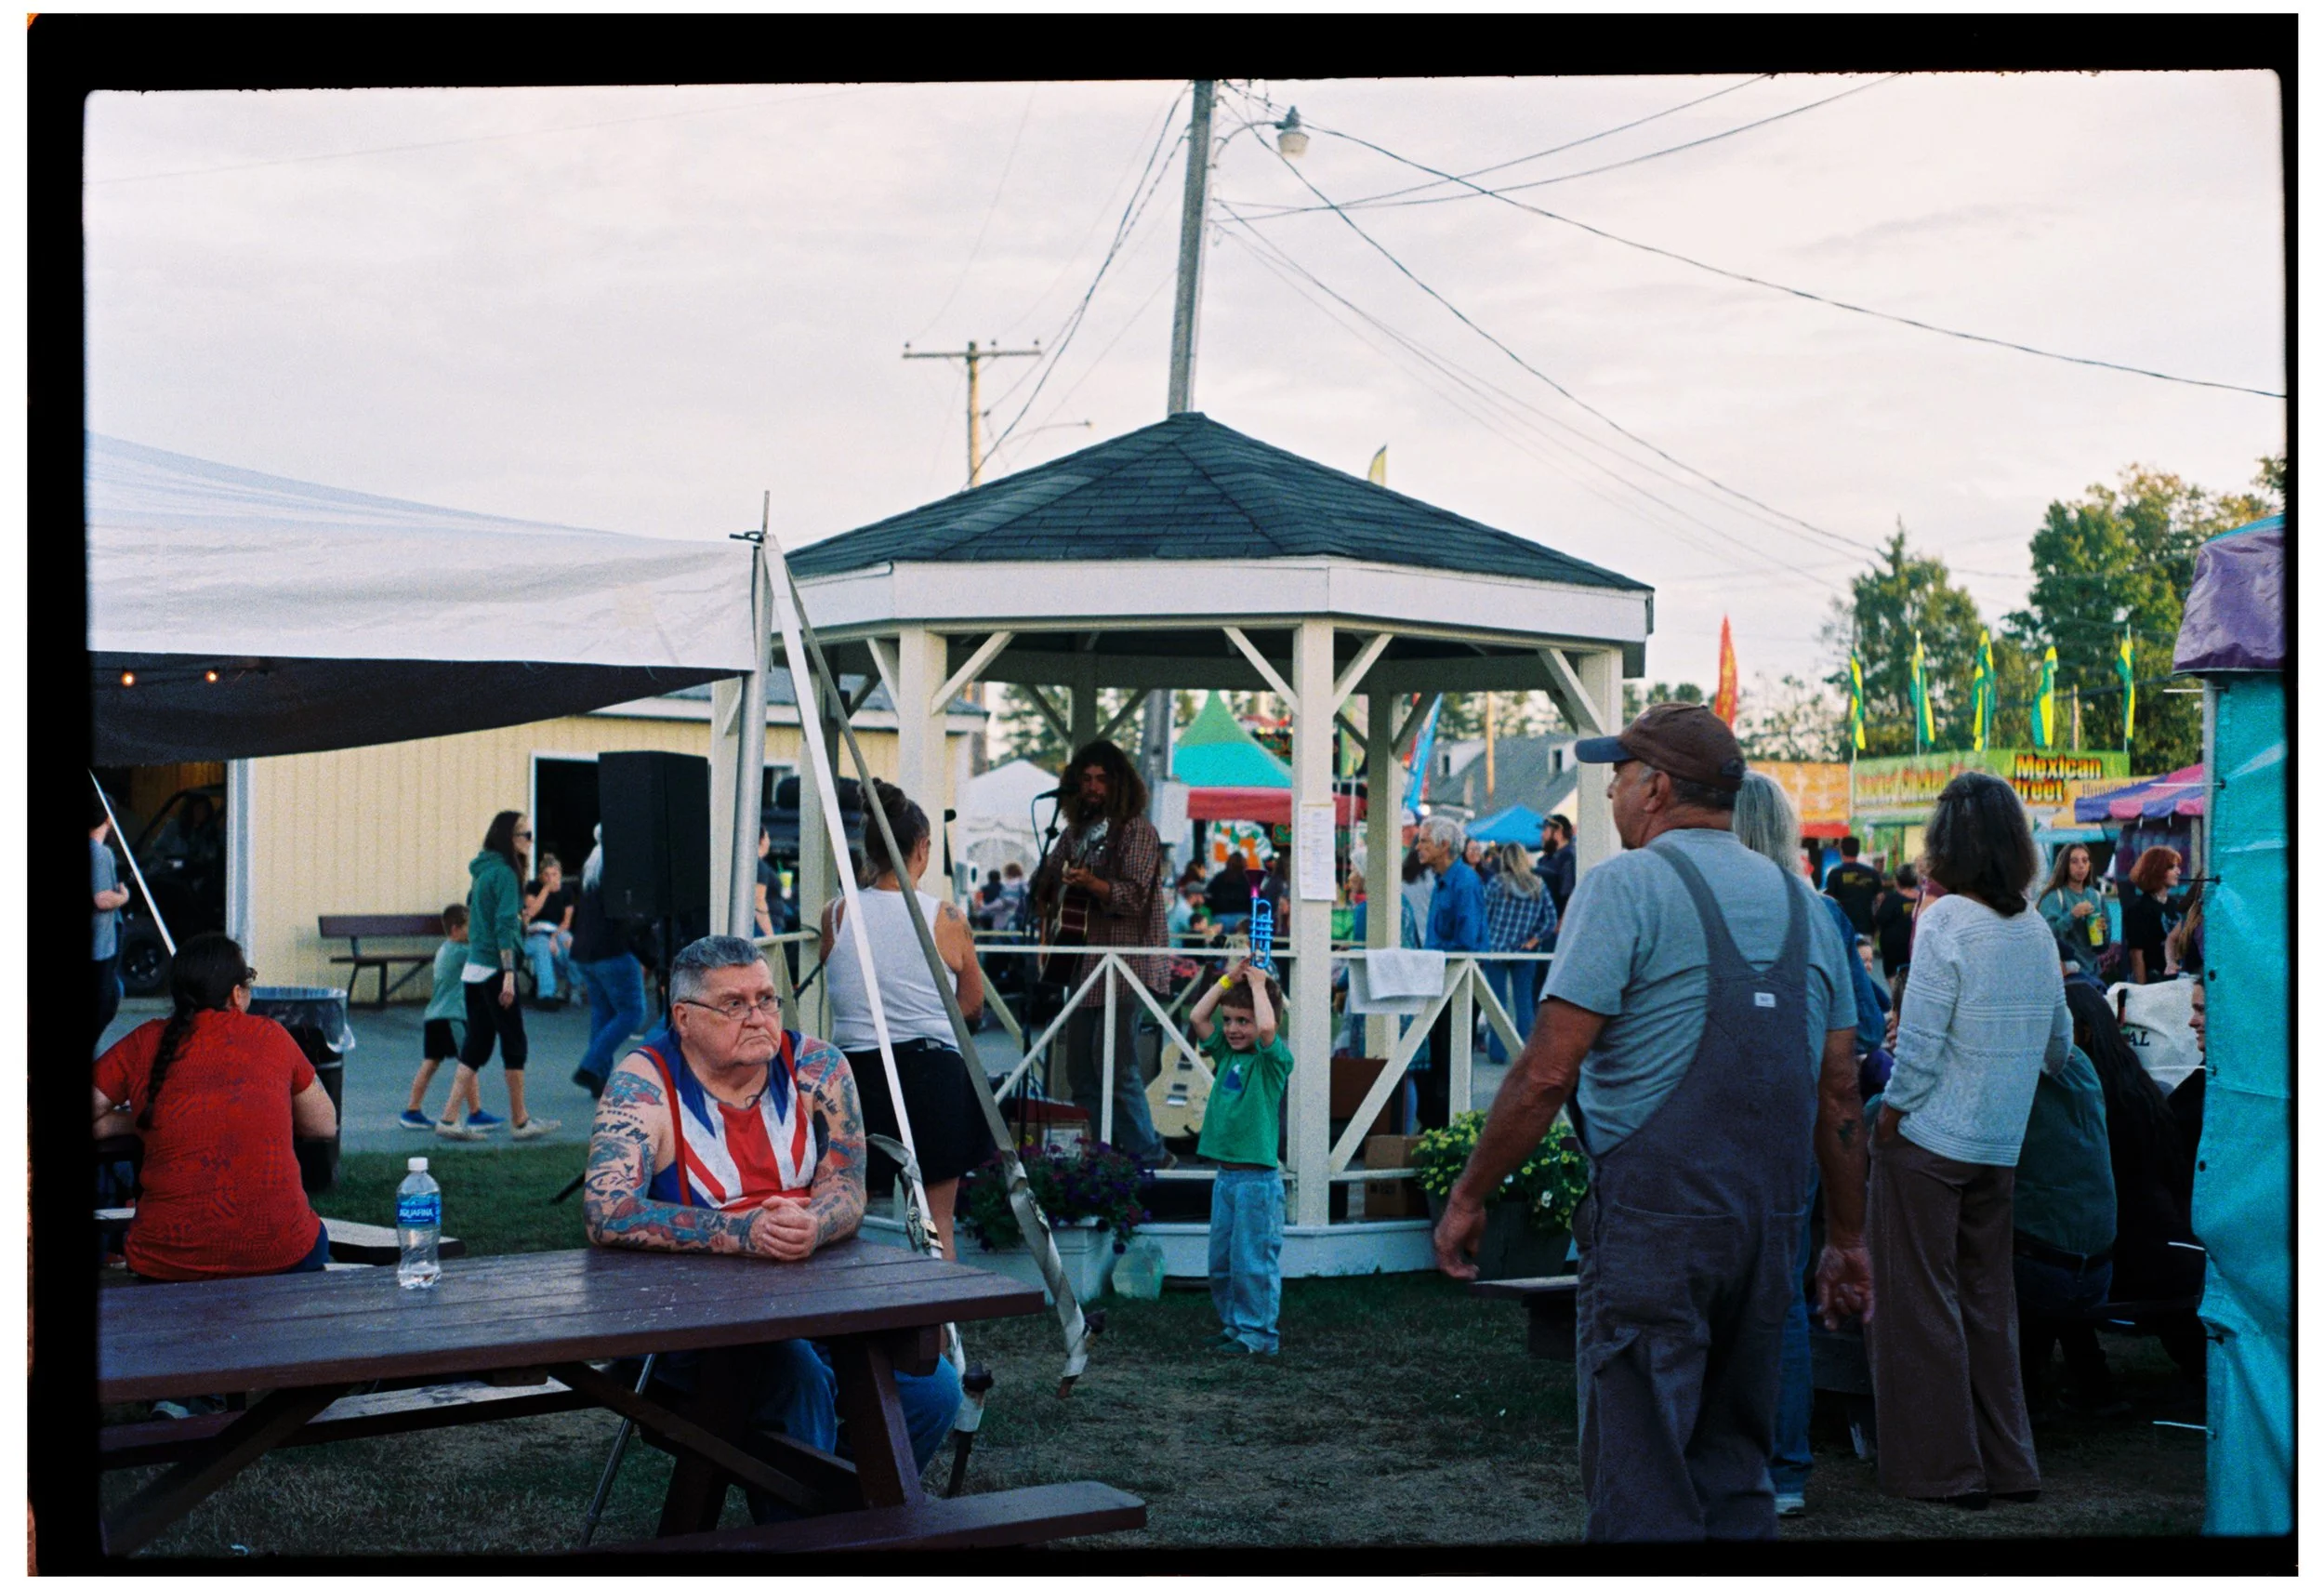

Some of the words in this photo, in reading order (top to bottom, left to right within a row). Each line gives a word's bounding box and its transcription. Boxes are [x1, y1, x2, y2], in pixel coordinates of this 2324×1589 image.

[2015, 753, 2103, 779] Mexican
[2008, 777, 2065, 802] treet
[399, 1208, 434, 1218] AQUAFINA
